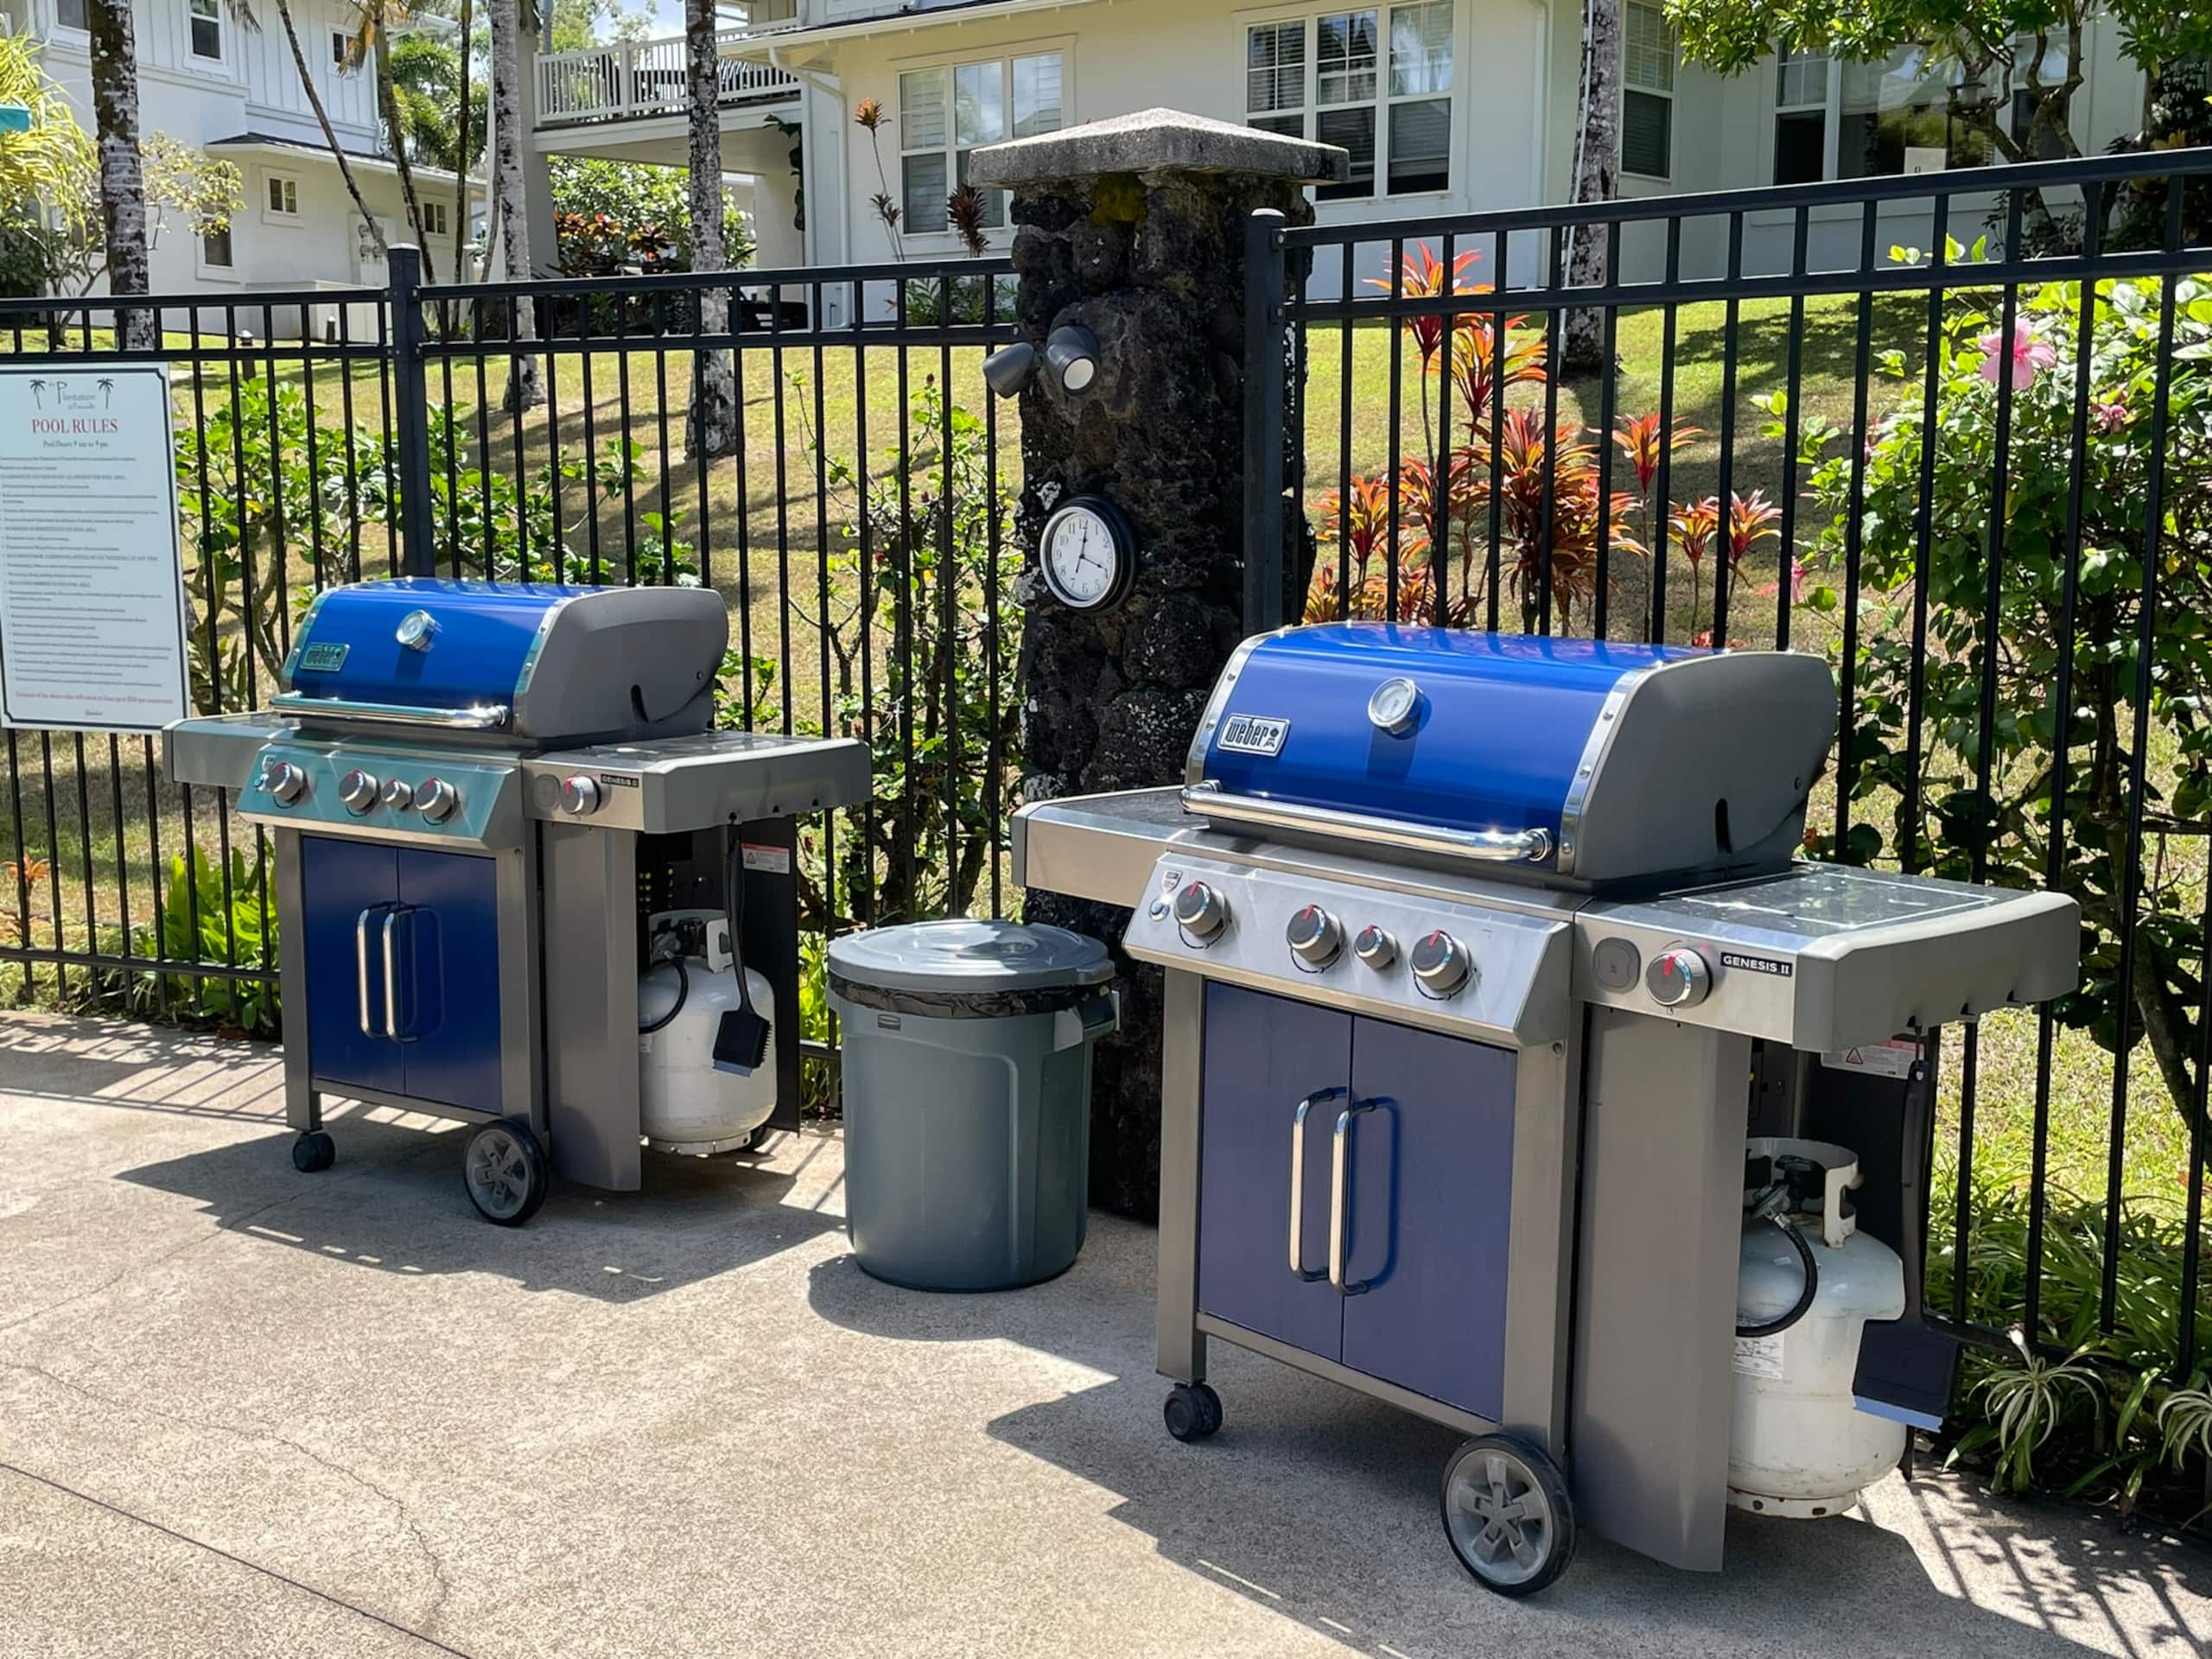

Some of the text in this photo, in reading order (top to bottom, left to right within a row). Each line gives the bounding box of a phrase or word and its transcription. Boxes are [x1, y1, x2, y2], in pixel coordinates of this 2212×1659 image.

[32, 419, 118, 434] POOL RULES
[1225, 718, 1269, 747] weber
[1723, 956, 1790, 975] GENESIS II
